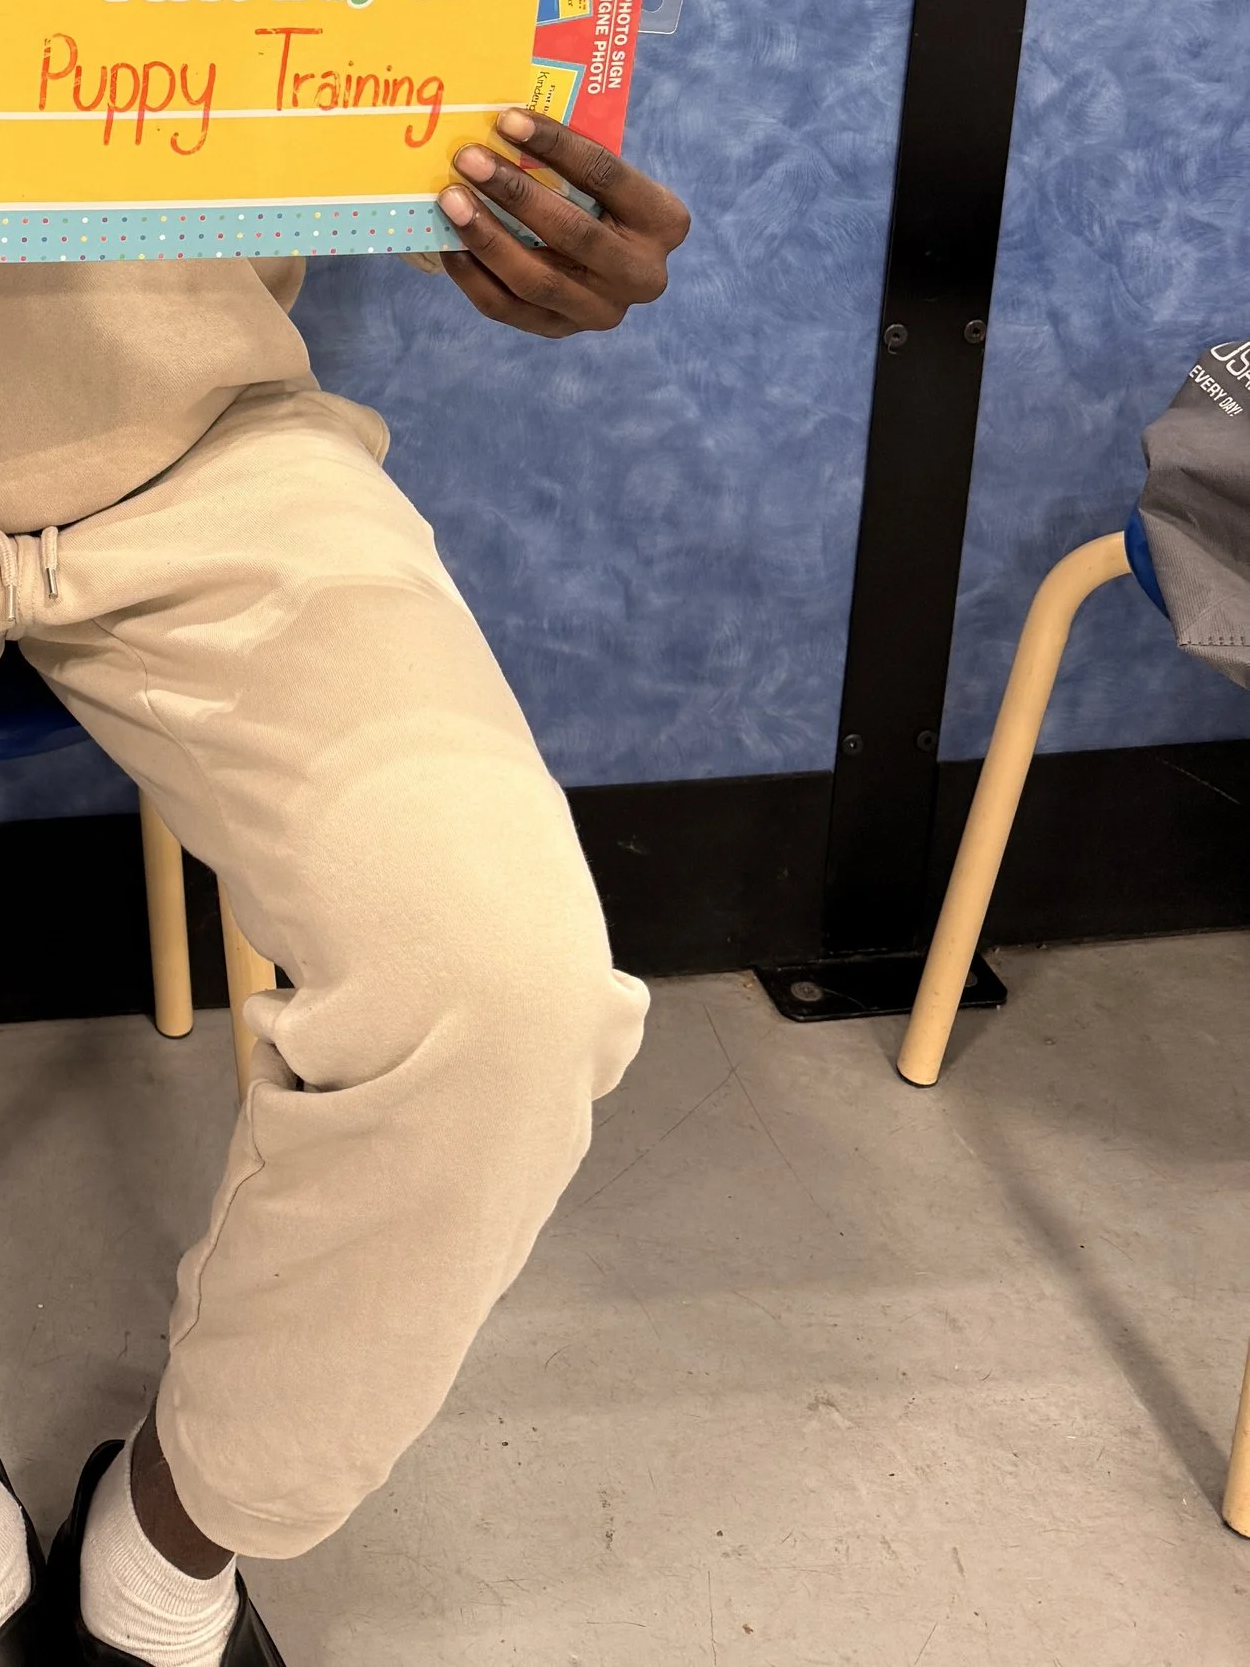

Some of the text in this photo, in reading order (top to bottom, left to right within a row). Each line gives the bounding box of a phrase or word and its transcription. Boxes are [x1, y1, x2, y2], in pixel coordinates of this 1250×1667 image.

[39, 27, 446, 156] Puppy Training
[587, 40, 607, 95] PHOTO
[608, 51, 626, 89] SIGN
[1189, 364, 1244, 417] EVERY DAY!
